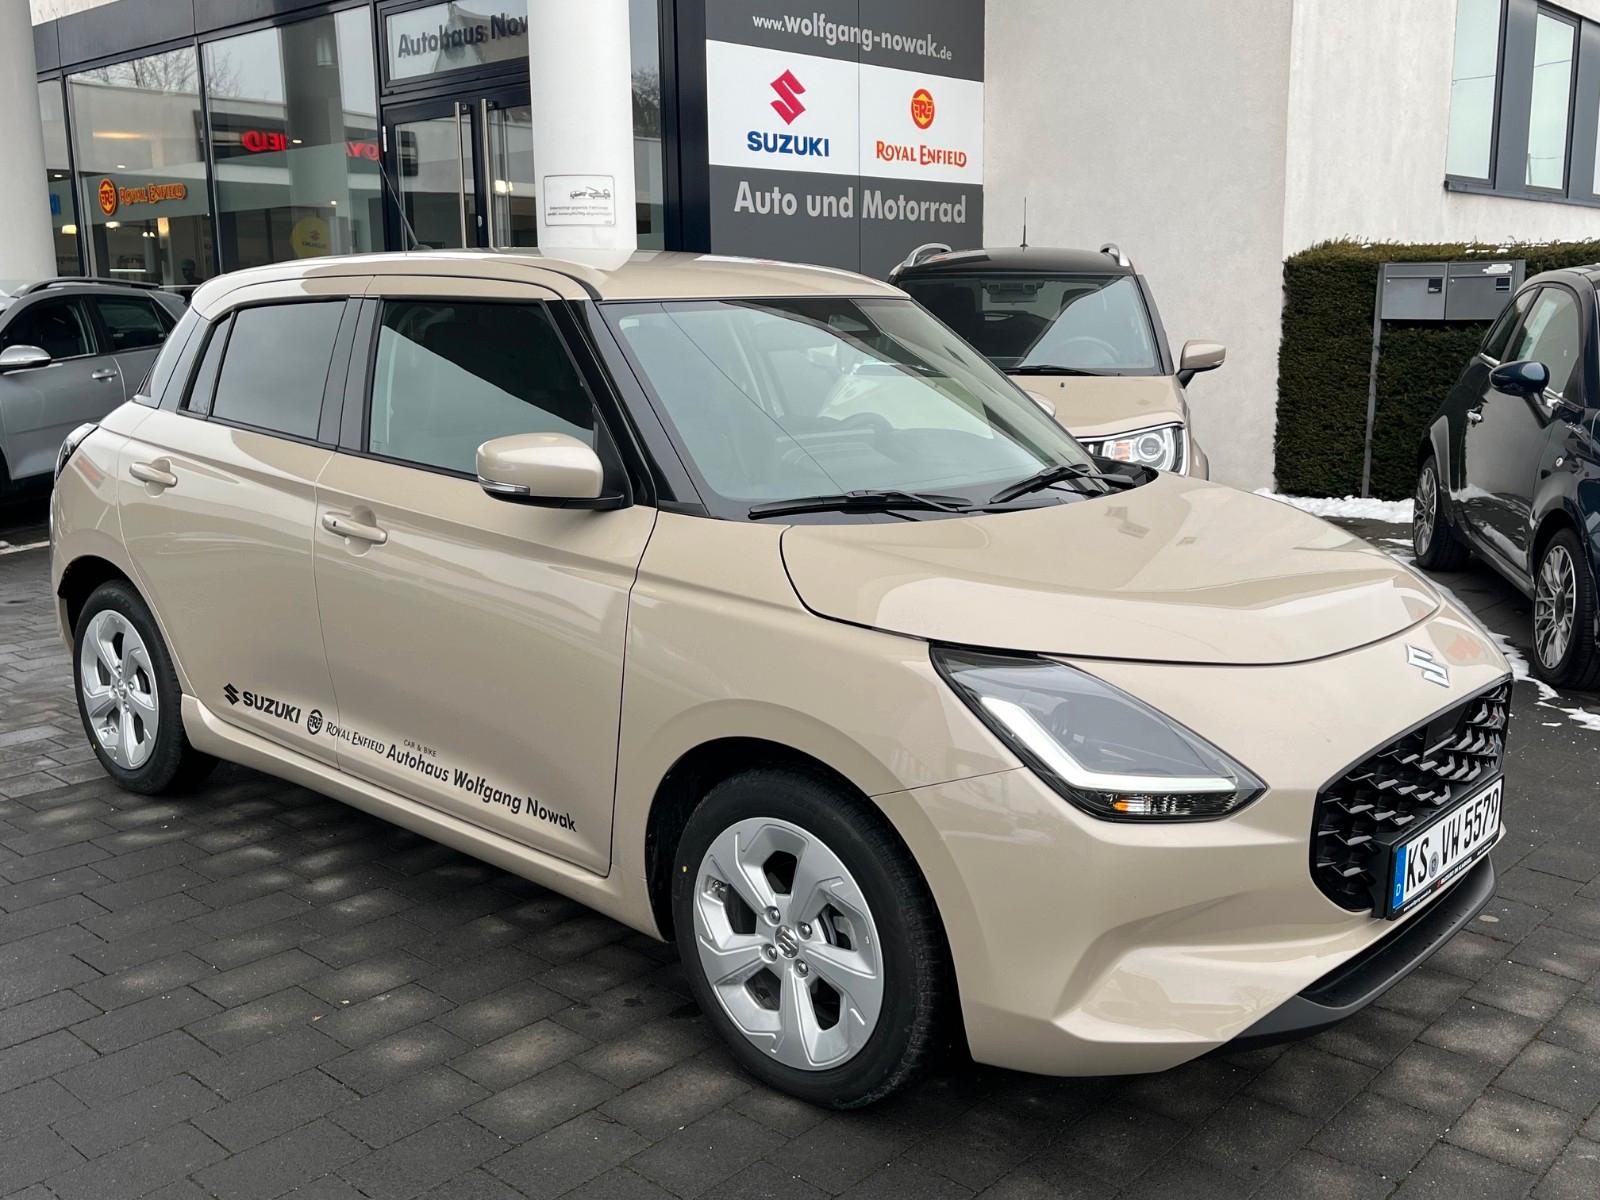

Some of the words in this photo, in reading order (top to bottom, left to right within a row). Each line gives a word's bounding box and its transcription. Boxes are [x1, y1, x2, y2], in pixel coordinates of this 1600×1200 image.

[398, 24, 485, 58] Autohaus
[490, 12, 528, 39] Now
[753, 12, 953, 61] www.wolfgang-nowak.de
[747, 131, 830, 157] SUZUKI
[876, 140, 917, 163] ROYAL
[919, 144, 967, 168] ENFIELD
[734, 181, 797, 216] Auto
[806, 187, 854, 218] und
[862, 189, 966, 224] Motorrad
[242, 691, 301, 724] SUZUKI
[326, 721, 350, 741] ROYAL
[351, 731, 385, 754] ENFIELD
[386, 744, 449, 782] Autohaus
[454, 768, 521, 814] Wolfgang
[526, 797, 576, 832] Nowak
[1406, 836, 1430, 893] KS
[1464, 787, 1499, 849] 5579
